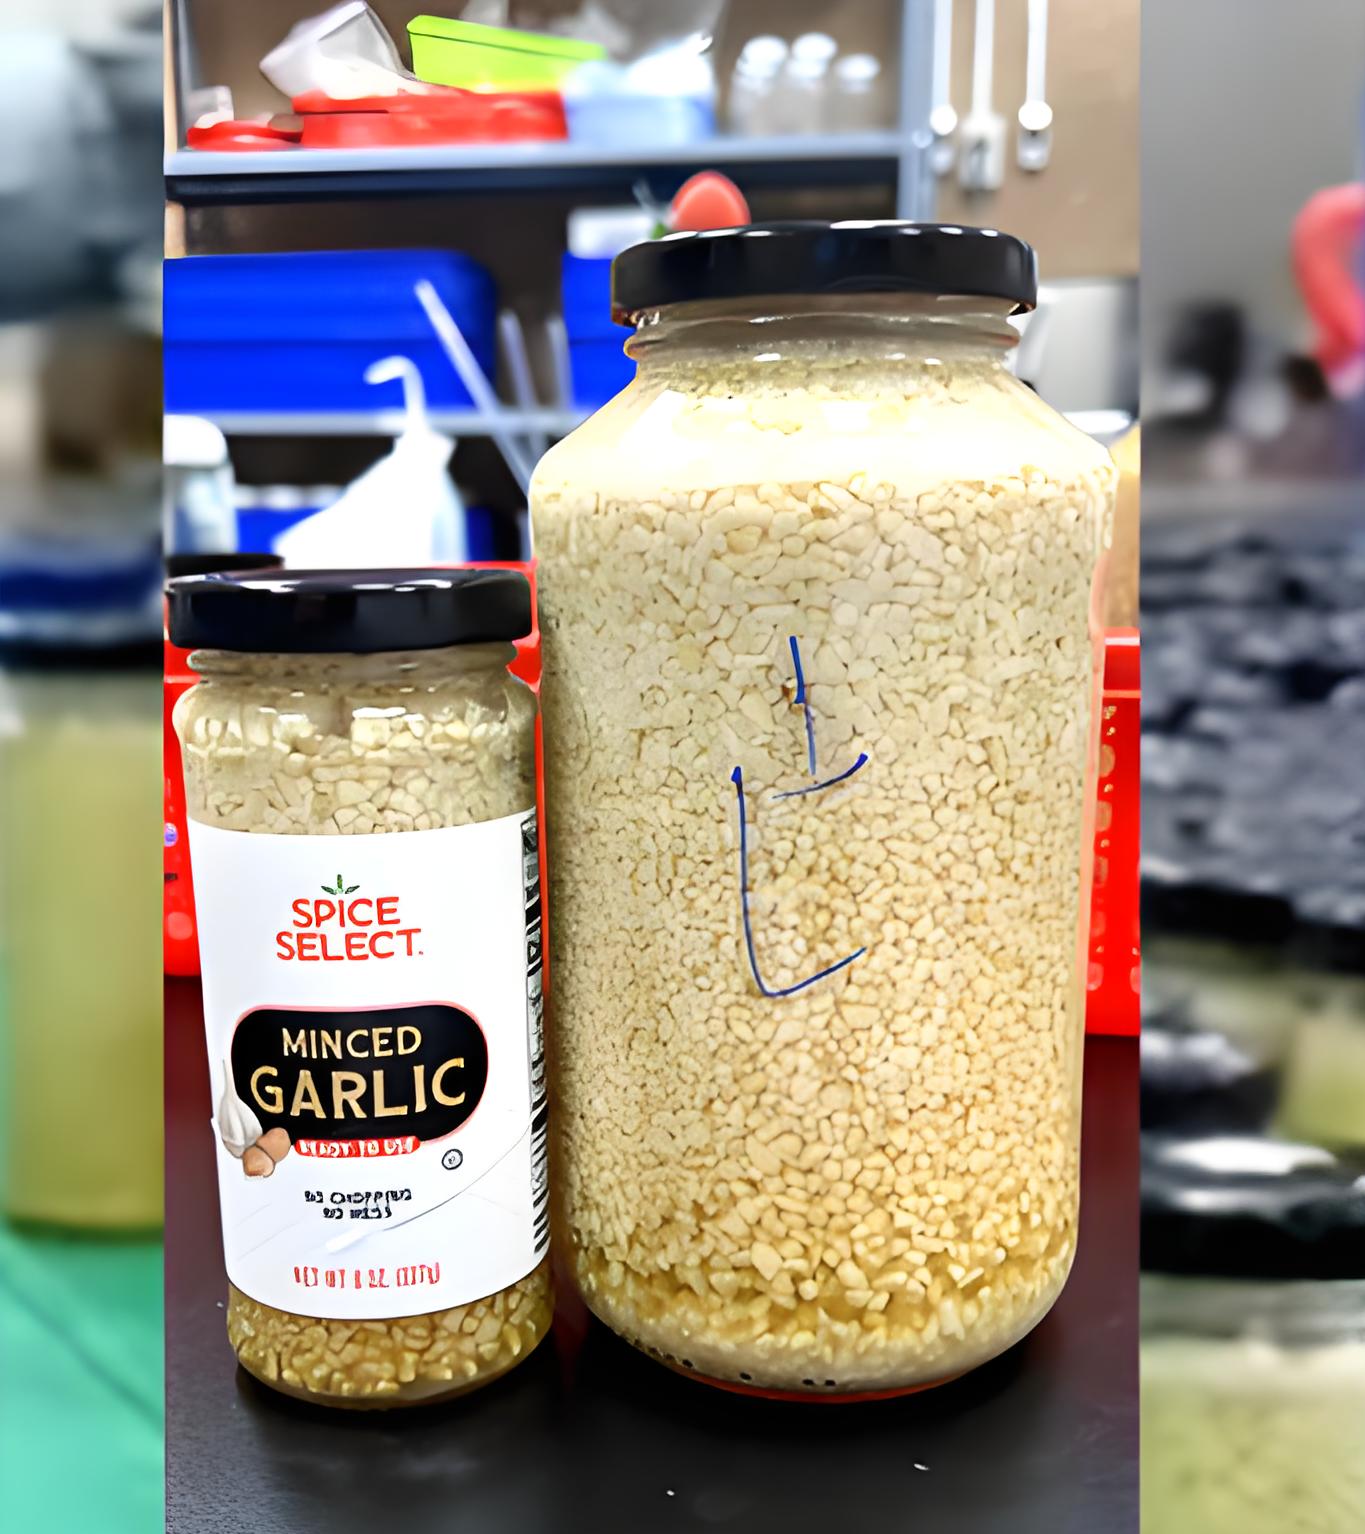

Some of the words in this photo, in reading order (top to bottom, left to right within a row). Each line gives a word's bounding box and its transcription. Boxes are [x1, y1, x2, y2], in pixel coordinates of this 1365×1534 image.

[291, 895, 402, 929] SPICE
[275, 928, 424, 962] SELECT
[281, 1024, 423, 1060] MINCED
[250, 1057, 467, 1120] GARLIC
